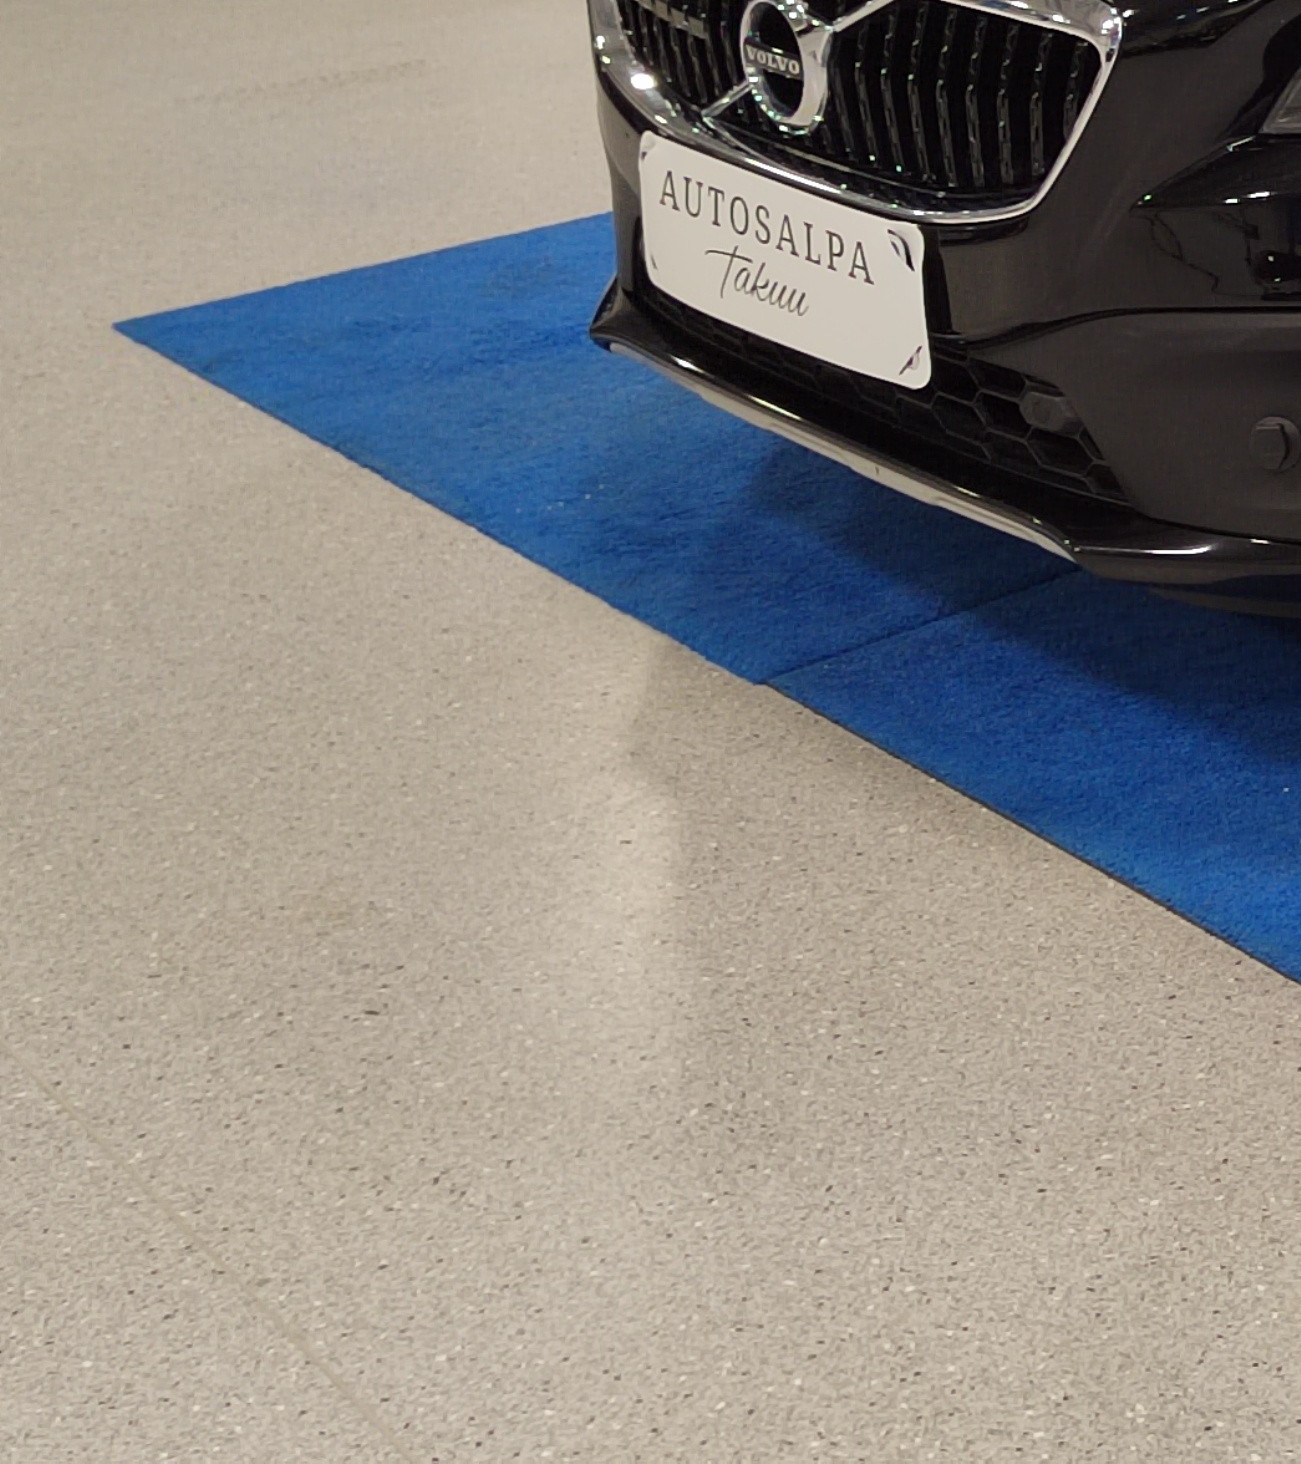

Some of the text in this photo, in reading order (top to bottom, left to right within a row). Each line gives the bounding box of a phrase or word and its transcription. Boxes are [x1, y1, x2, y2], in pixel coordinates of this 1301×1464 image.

[745, 44, 800, 75] VOLVO
[659, 170, 875, 286] AUTOSALPA
[705, 245, 810, 317] Takuu
